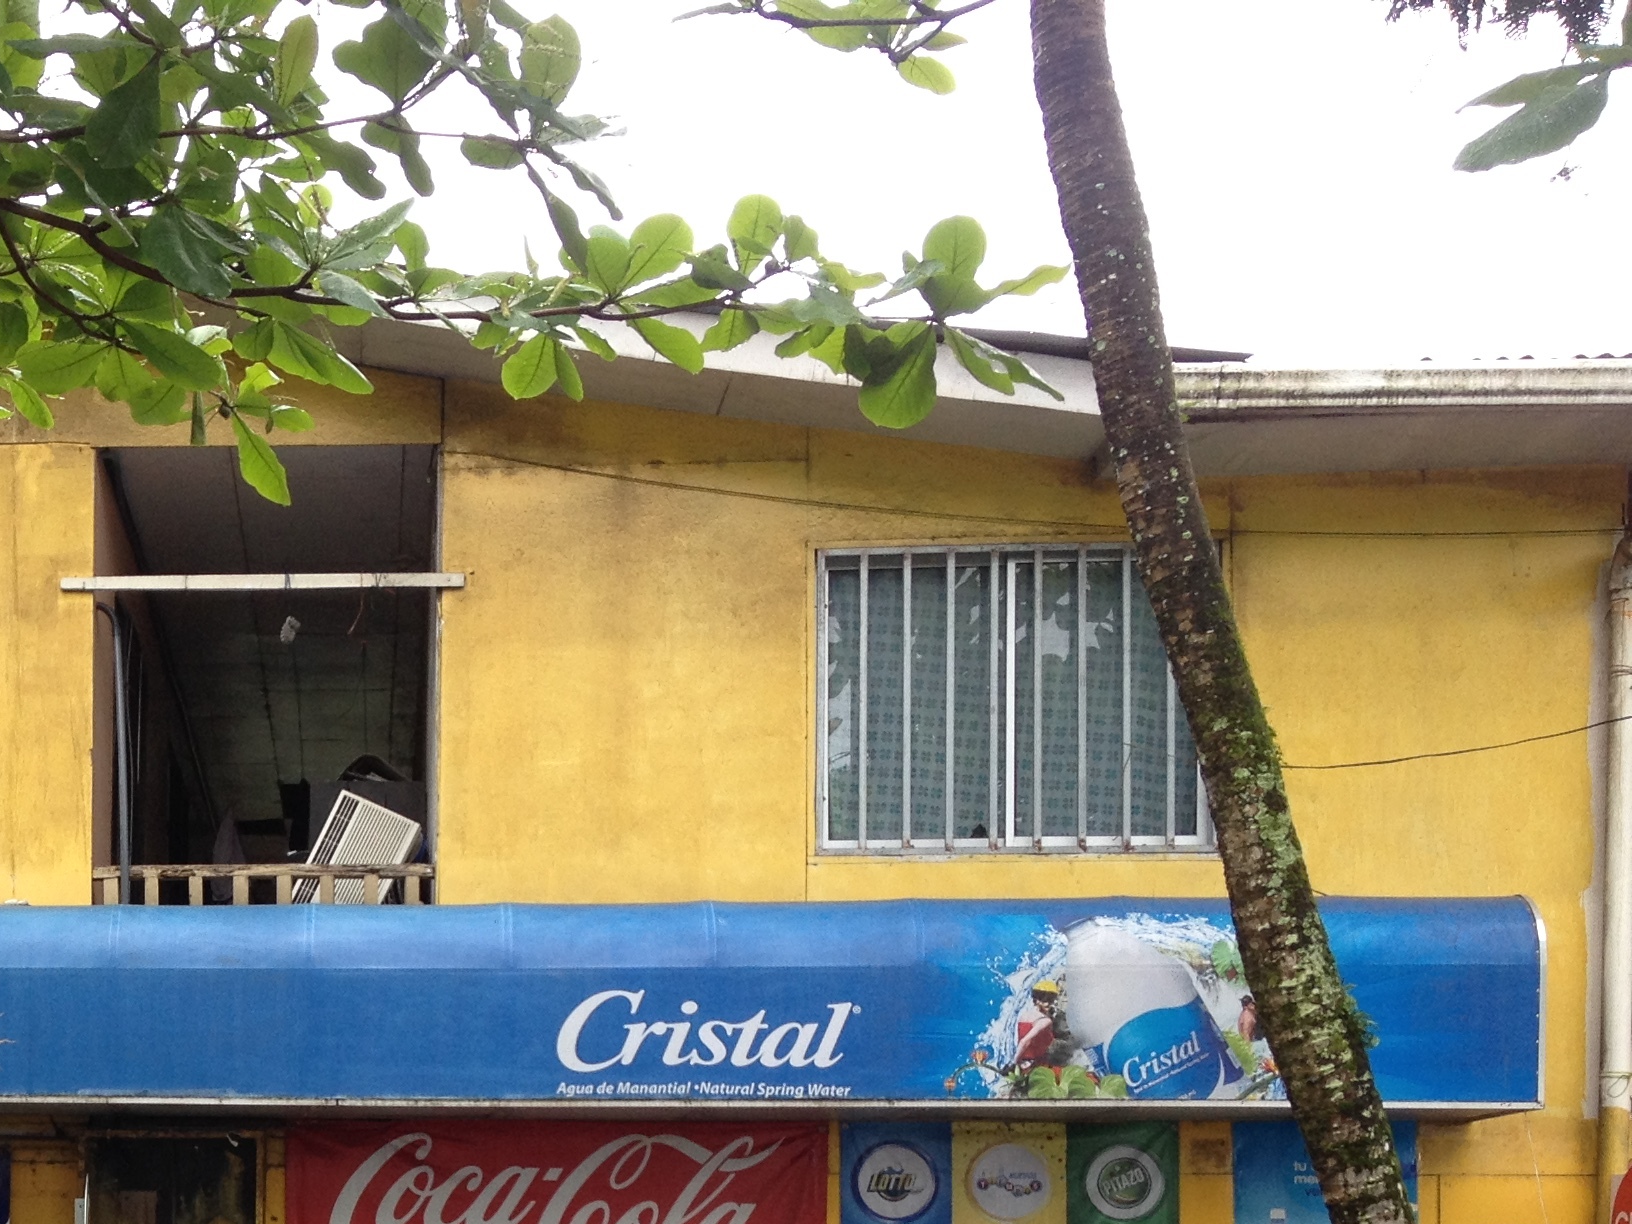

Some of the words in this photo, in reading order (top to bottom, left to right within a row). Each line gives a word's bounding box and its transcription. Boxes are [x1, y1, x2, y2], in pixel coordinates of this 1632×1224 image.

[555, 990, 853, 1073] Cristal
[1123, 1030, 1201, 1088] Cristal
[556, 1081, 593, 1097] Agua
[596, 1082, 614, 1095] de
[617, 1081, 691, 1095] Manantial
[756, 1083, 805, 1098] Spring
[807, 1083, 851, 1097] Water
[1102, 1167, 1145, 1195] PITAZO
